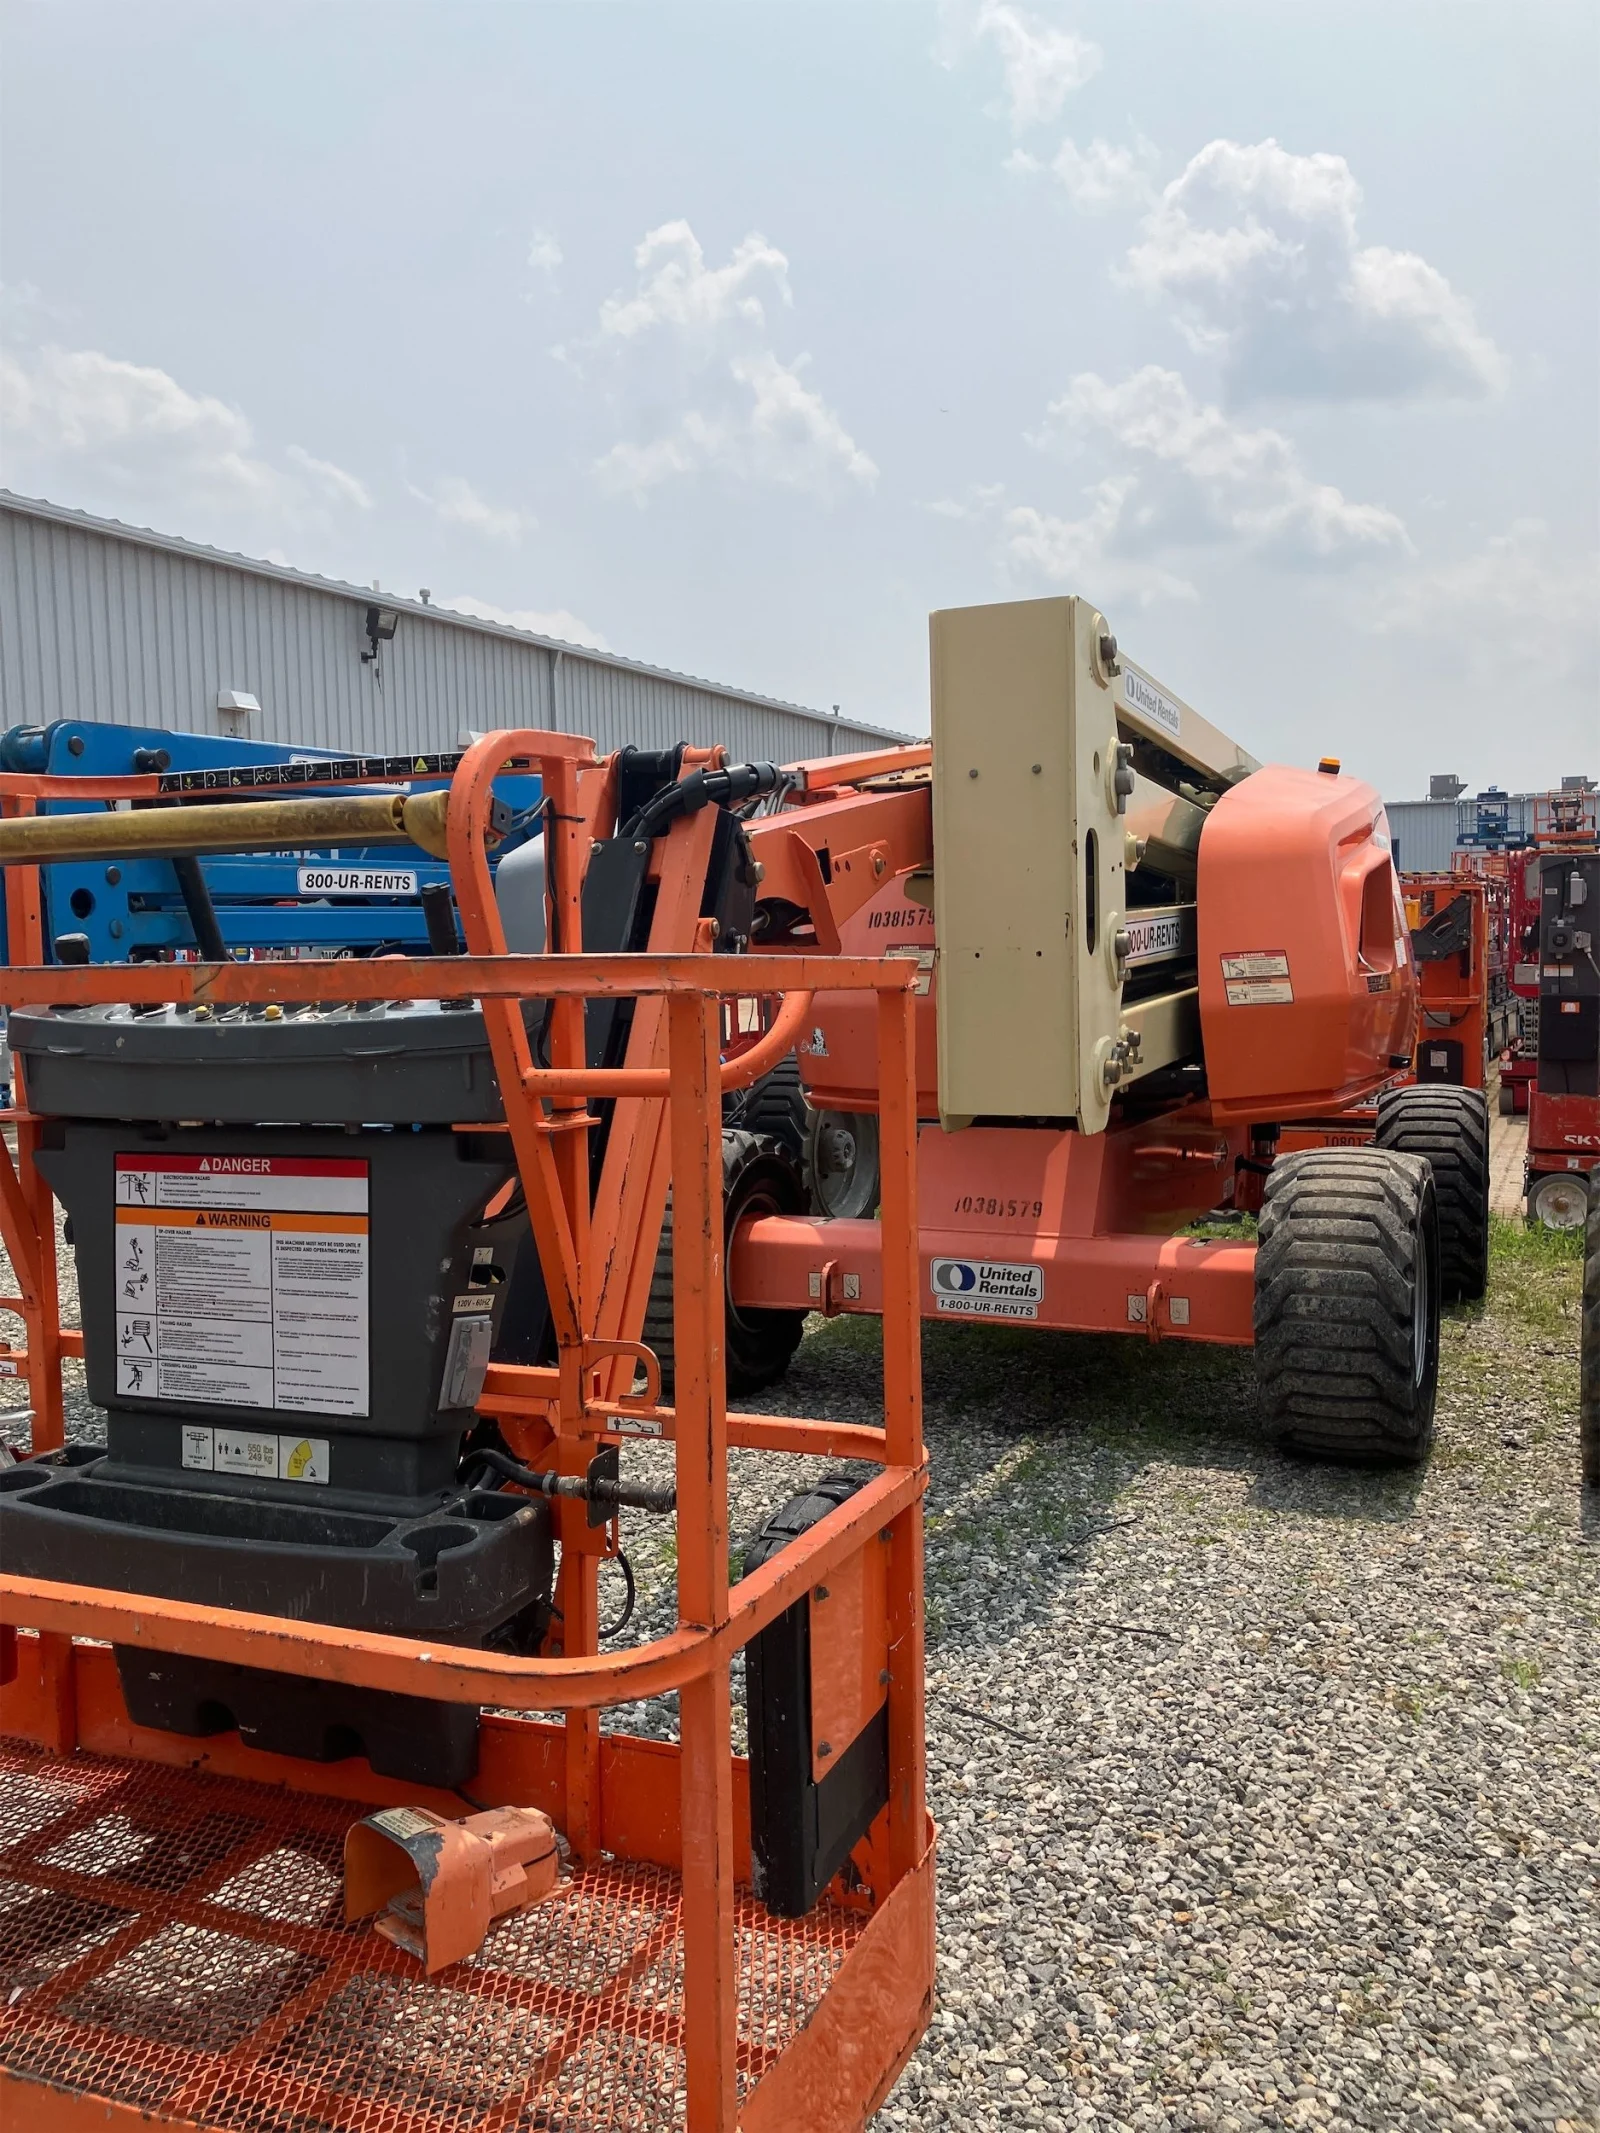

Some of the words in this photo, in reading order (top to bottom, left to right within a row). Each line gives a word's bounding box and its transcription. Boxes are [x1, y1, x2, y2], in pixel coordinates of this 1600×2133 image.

[1136, 682, 1157, 713] United
[1158, 698, 1178, 730] Rentals
[305, 873, 410, 890] 800-UR-RENTS
[868, 909, 935, 929] 10381579
[1127, 922, 1180, 952] 00-UR-RENTS
[213, 1158, 271, 1172] DANGER
[954, 1196, 1043, 1218] 10381579
[208, 1213, 271, 1228] WARNING
[979, 1266, 1033, 1283] United
[979, 1280, 1038, 1297] Rentals
[457, 1299, 472, 1307] 120V
[940, 1299, 1034, 1316] 1-800-UR-RENTS
[248, 1443, 261, 1453] 550
[263, 1445, 273, 1454] lbs
[248, 1452, 262, 1461] 249
[264, 1453, 273, 1464] kg
